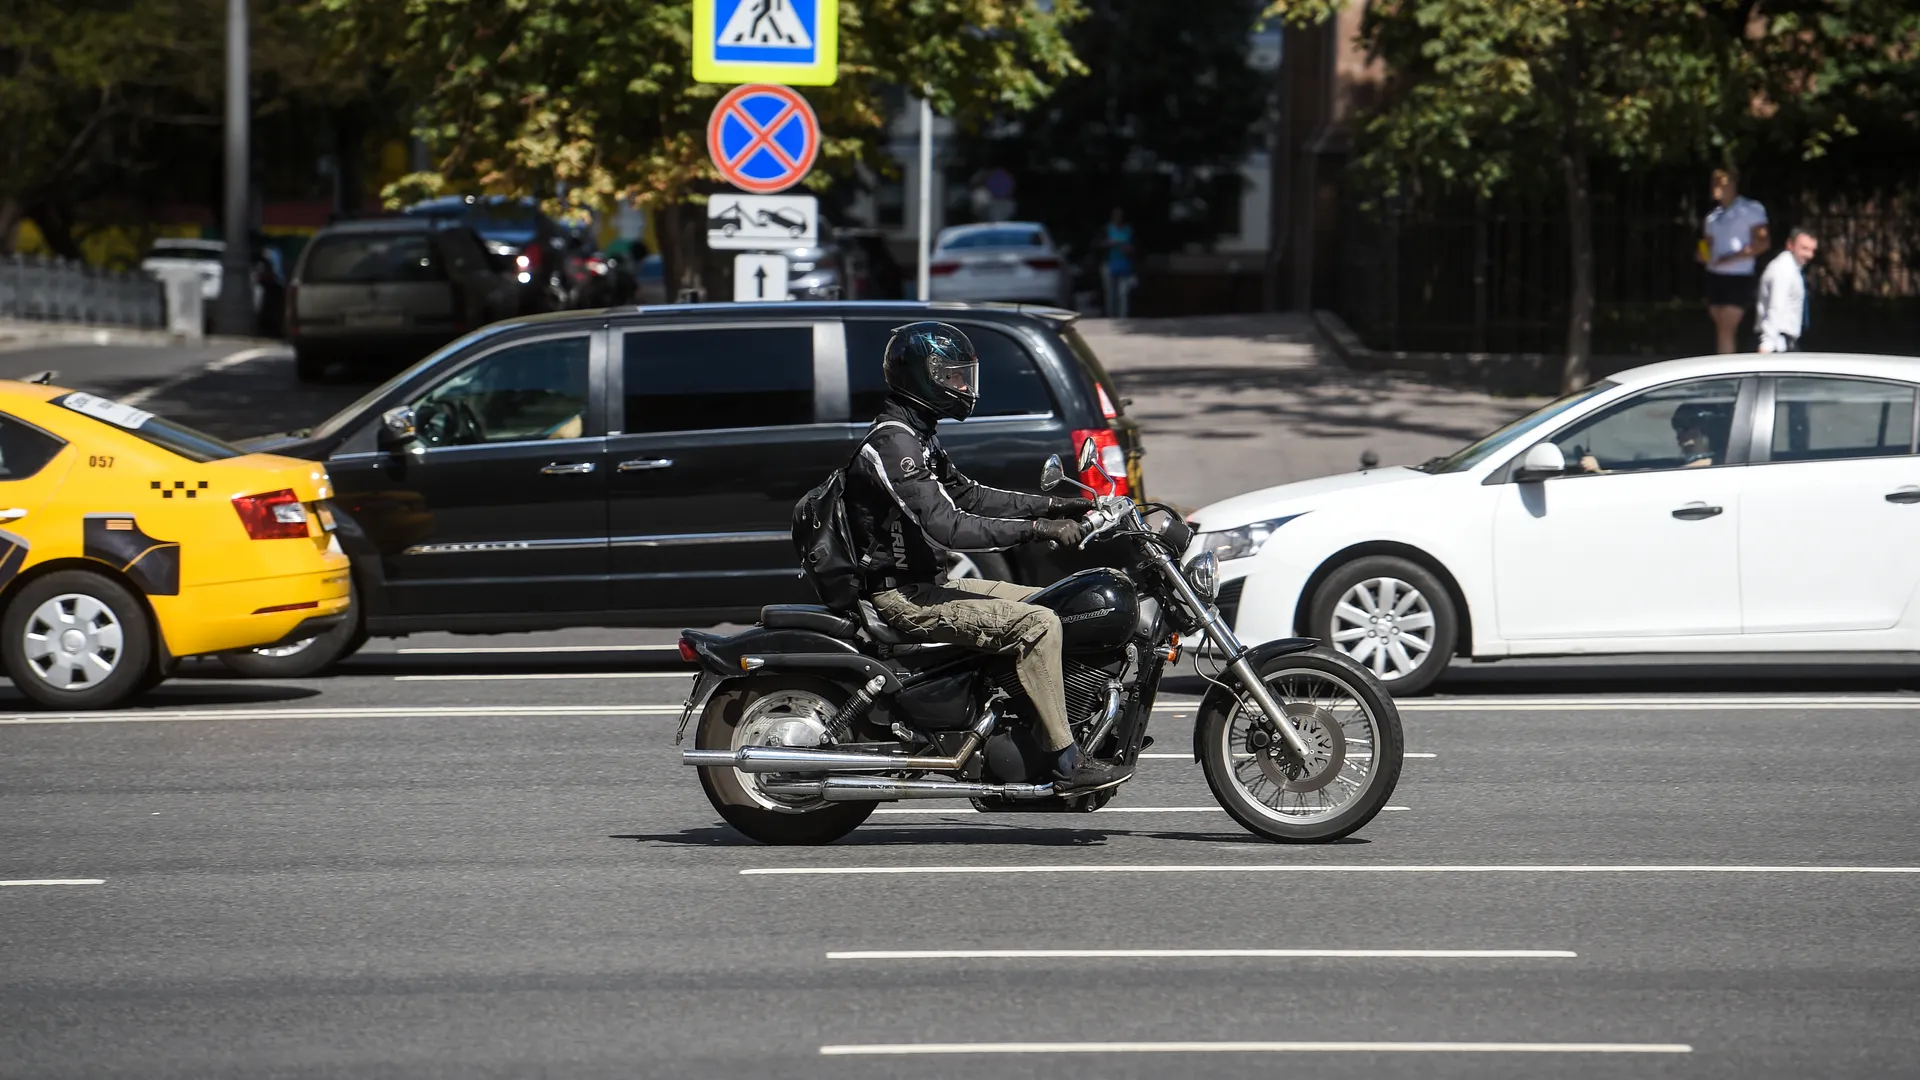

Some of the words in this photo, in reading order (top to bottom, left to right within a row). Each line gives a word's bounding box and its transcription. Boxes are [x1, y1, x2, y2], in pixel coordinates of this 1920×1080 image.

[89, 455, 115, 468] 057
[890, 520, 909, 571] ERIN
[1060, 607, 1110, 624] esperado
